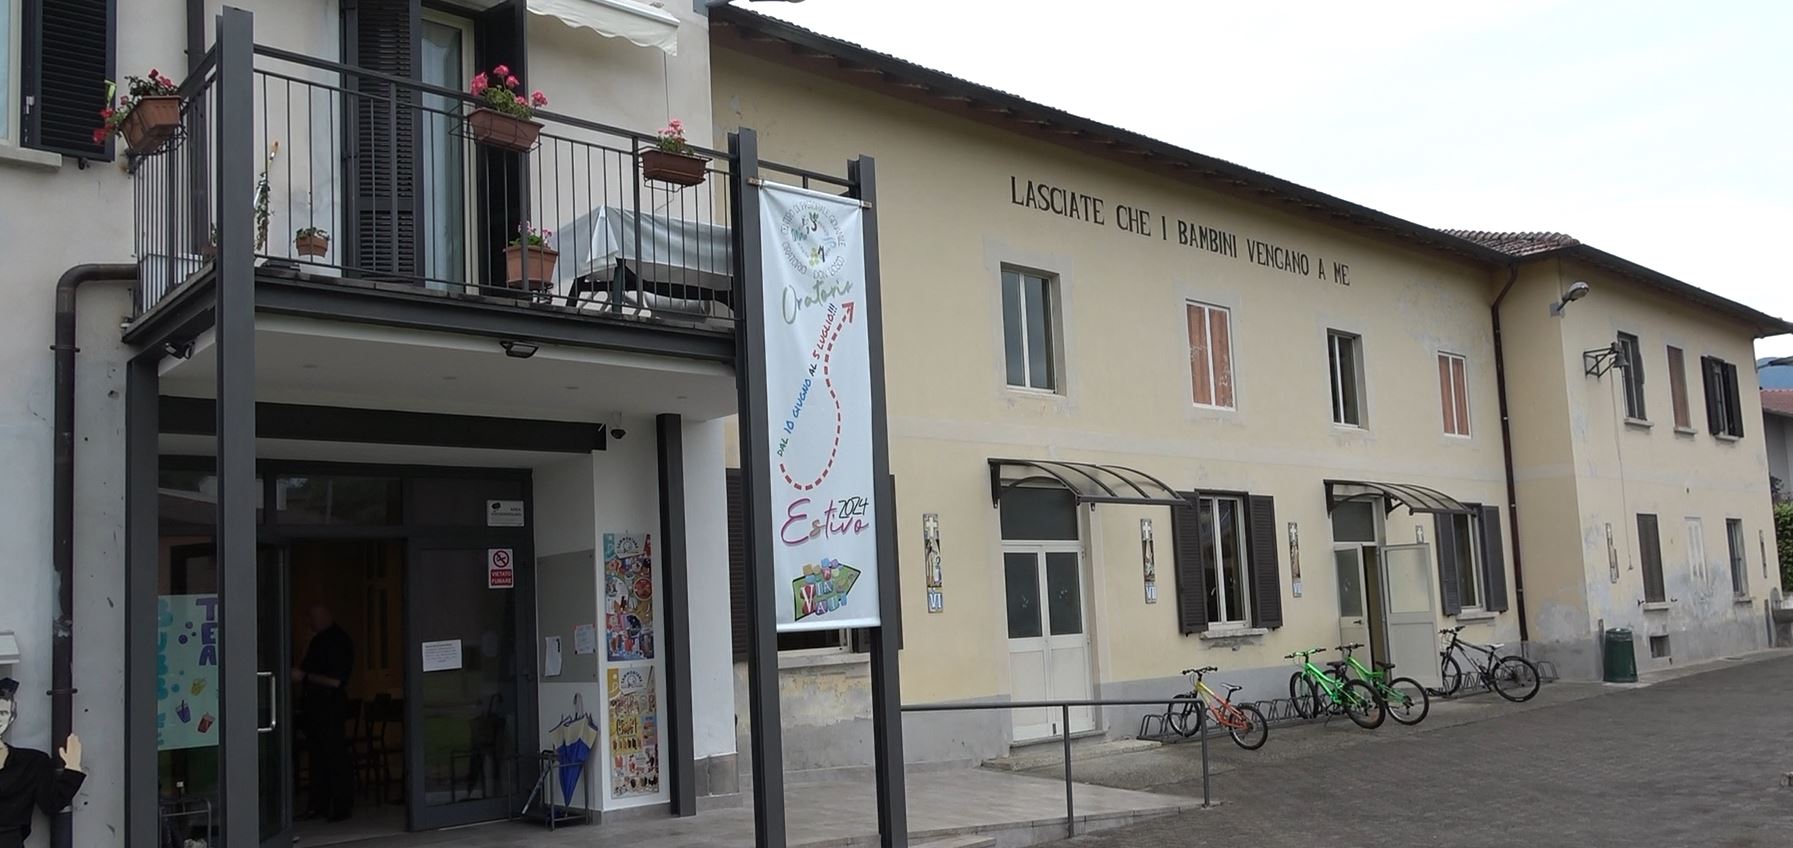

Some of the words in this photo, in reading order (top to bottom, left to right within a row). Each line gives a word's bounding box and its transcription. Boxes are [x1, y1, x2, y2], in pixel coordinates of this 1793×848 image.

[1011, 176, 1105, 225] LASCIATE
[1116, 204, 1151, 237] CHE
[1161, 215, 1168, 240] I
[1178, 220, 1237, 258] BAMBINI
[1247, 239, 1309, 276] VENGANO
[1318, 259, 1326, 280] A
[1333, 262, 1350, 286] ME
[812, 349, 821, 360] 5
[808, 363, 817, 377] AL
[792, 378, 811, 418] GIUGNO
[783, 420, 795, 434] 10
[777, 438, 789, 457] DAL
[838, 496, 869, 519] 2024
[780, 497, 870, 547] Estivo
[928, 592, 943, 609] VI
[196, 597, 219, 666] TEA
